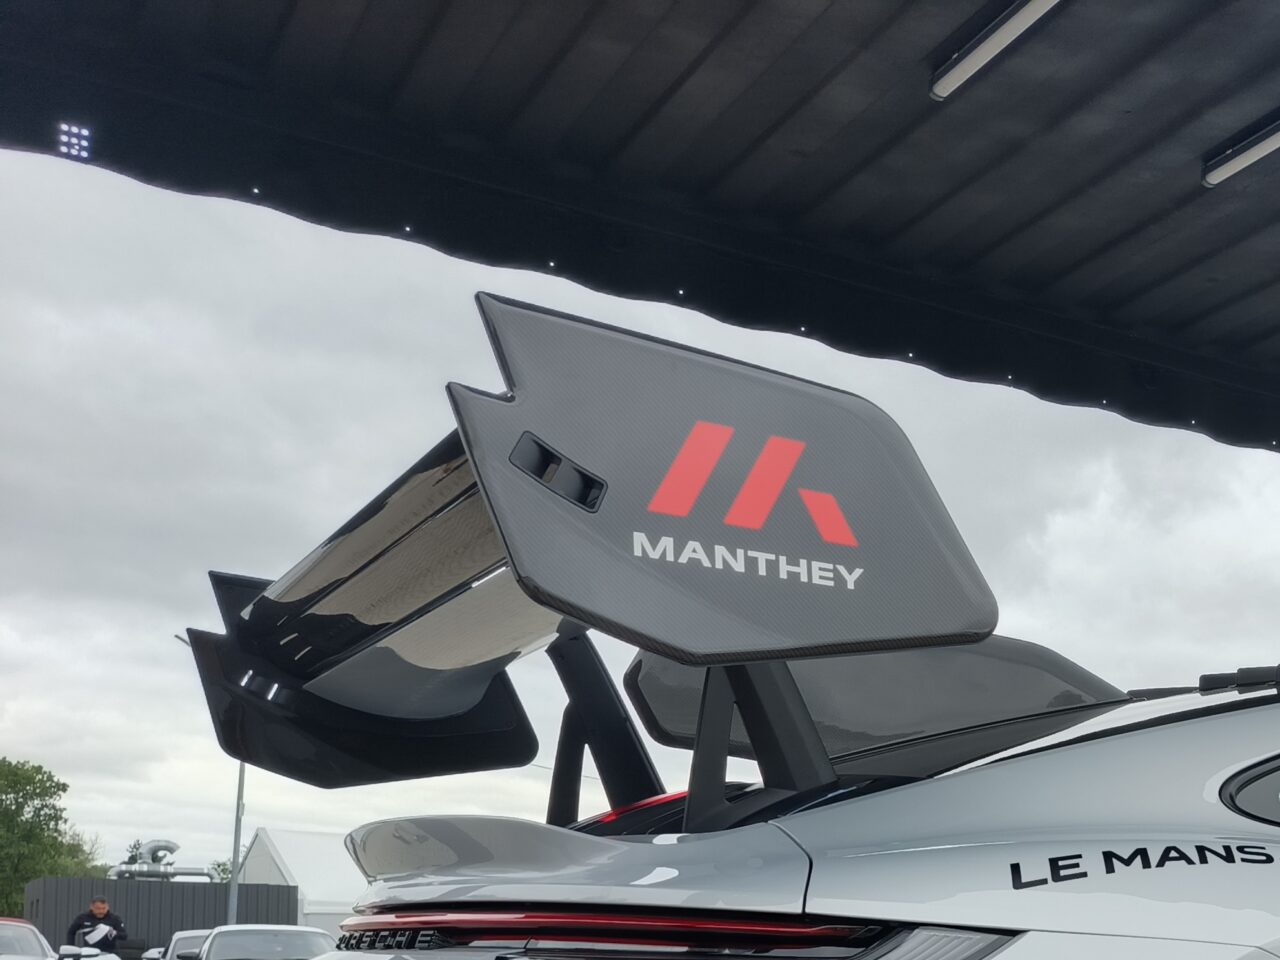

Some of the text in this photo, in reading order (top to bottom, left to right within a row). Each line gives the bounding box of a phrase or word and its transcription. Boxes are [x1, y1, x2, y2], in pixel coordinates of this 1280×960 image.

[633, 531, 864, 590] MANTHEY
[1010, 845, 1275, 890] LE MANS
